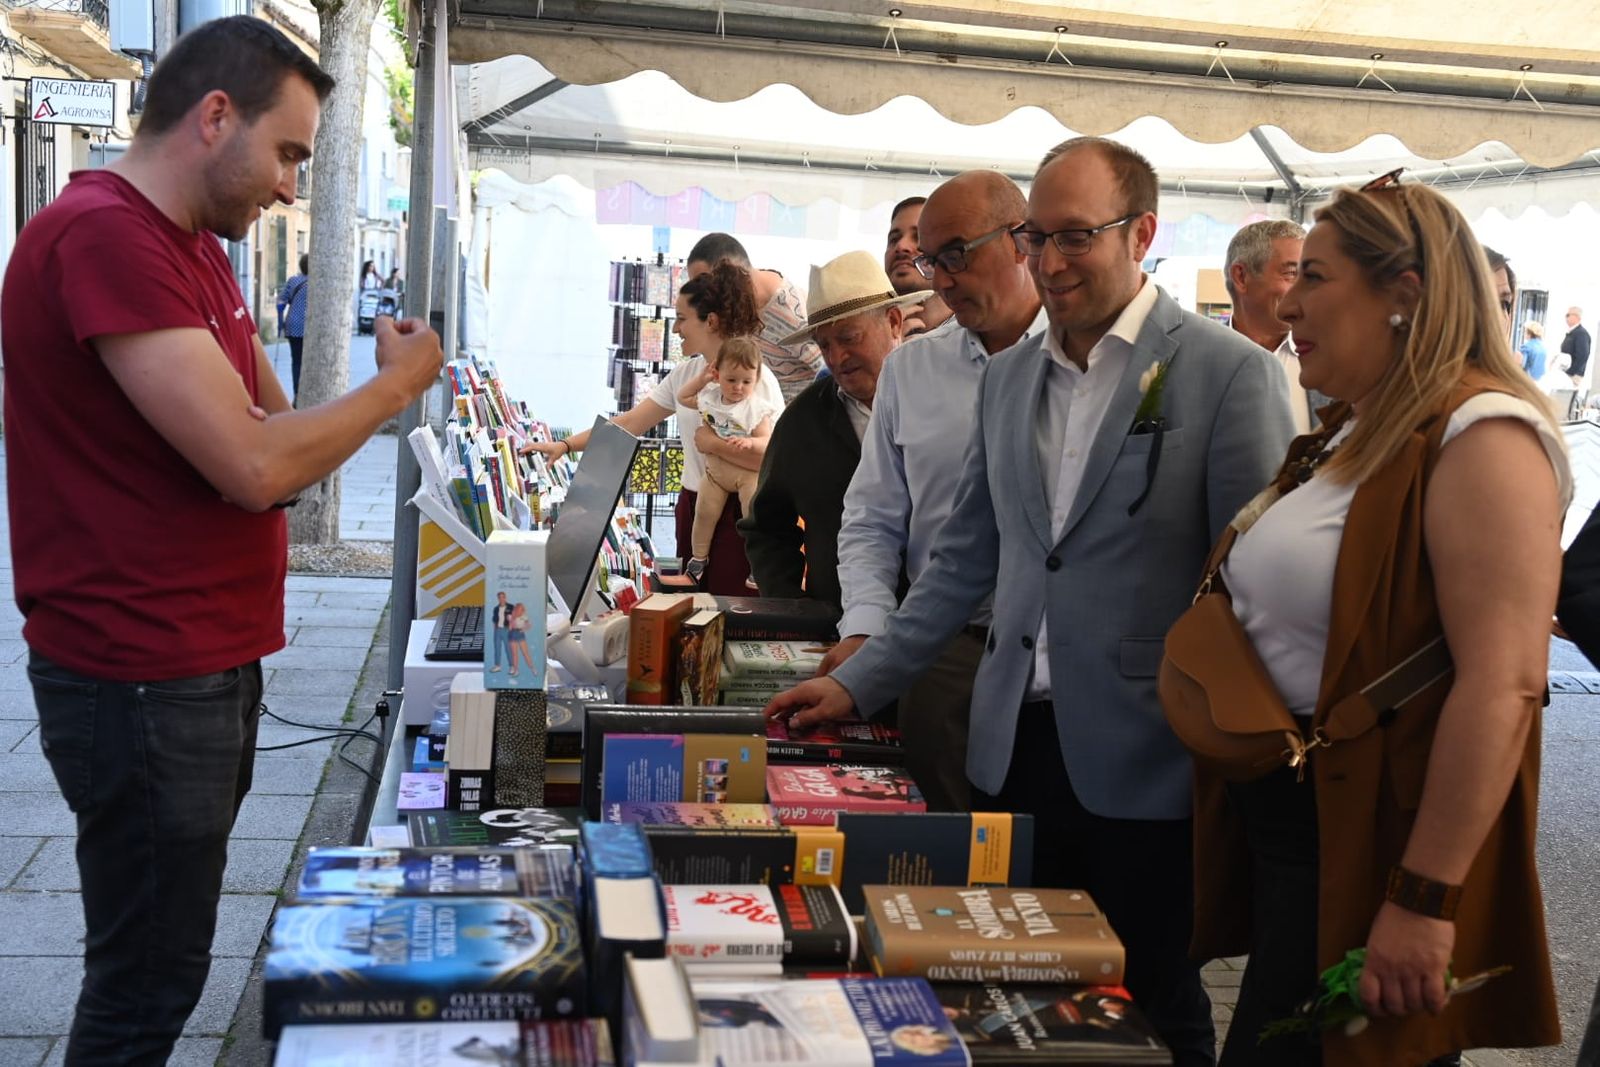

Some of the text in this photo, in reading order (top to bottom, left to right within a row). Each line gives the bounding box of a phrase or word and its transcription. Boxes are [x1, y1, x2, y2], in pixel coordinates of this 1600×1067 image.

[35, 81, 112, 99] INGENIERIA
[60, 107, 112, 119] AGROINSA
[781, 747, 804, 755] COLLEEN
[429, 855, 454, 892] PINTOR
[479, 855, 502, 891] ALMAS
[956, 889, 1015, 940] SOMBRA
[1011, 893, 1060, 936] VIENTO
[1019, 951, 1062, 962] CARLOS
[927, 965, 985, 982] VIENTO
[1002, 965, 1068, 982] SOMBRA
[986, 987, 1018, 1022] CARLOS
[1008, 1023, 1037, 1051] JUAN
